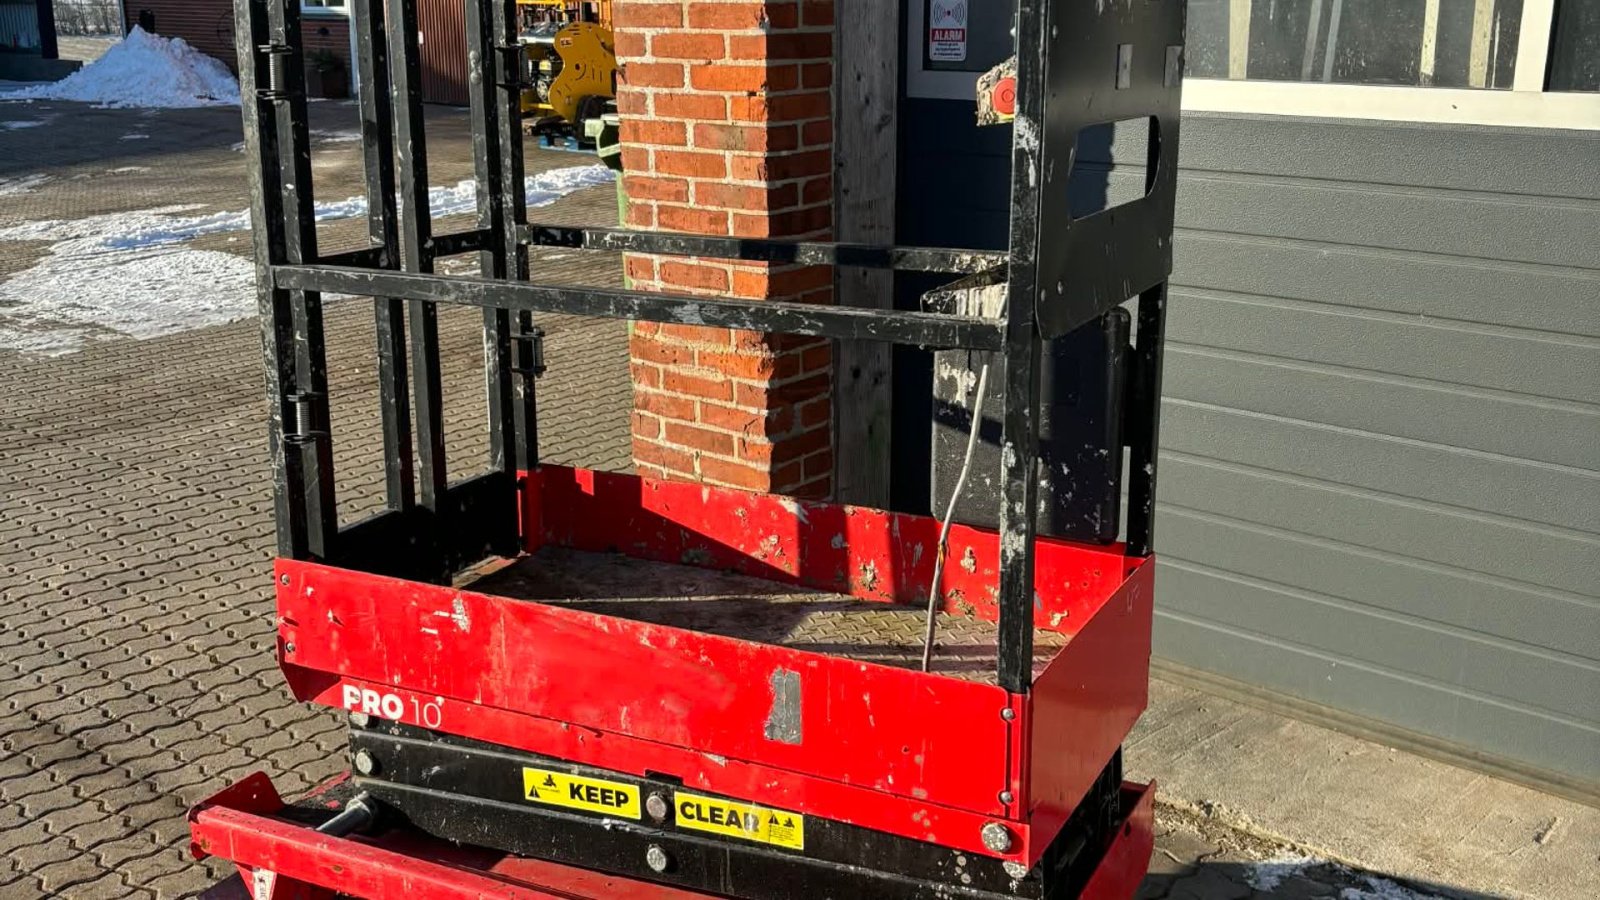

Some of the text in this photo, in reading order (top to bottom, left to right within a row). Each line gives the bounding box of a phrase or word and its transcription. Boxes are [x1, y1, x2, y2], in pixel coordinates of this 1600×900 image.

[934, 30, 963, 41] ALARM
[342, 684, 442, 728] PRO 10
[569, 783, 760, 833] KEEP CLEAR
